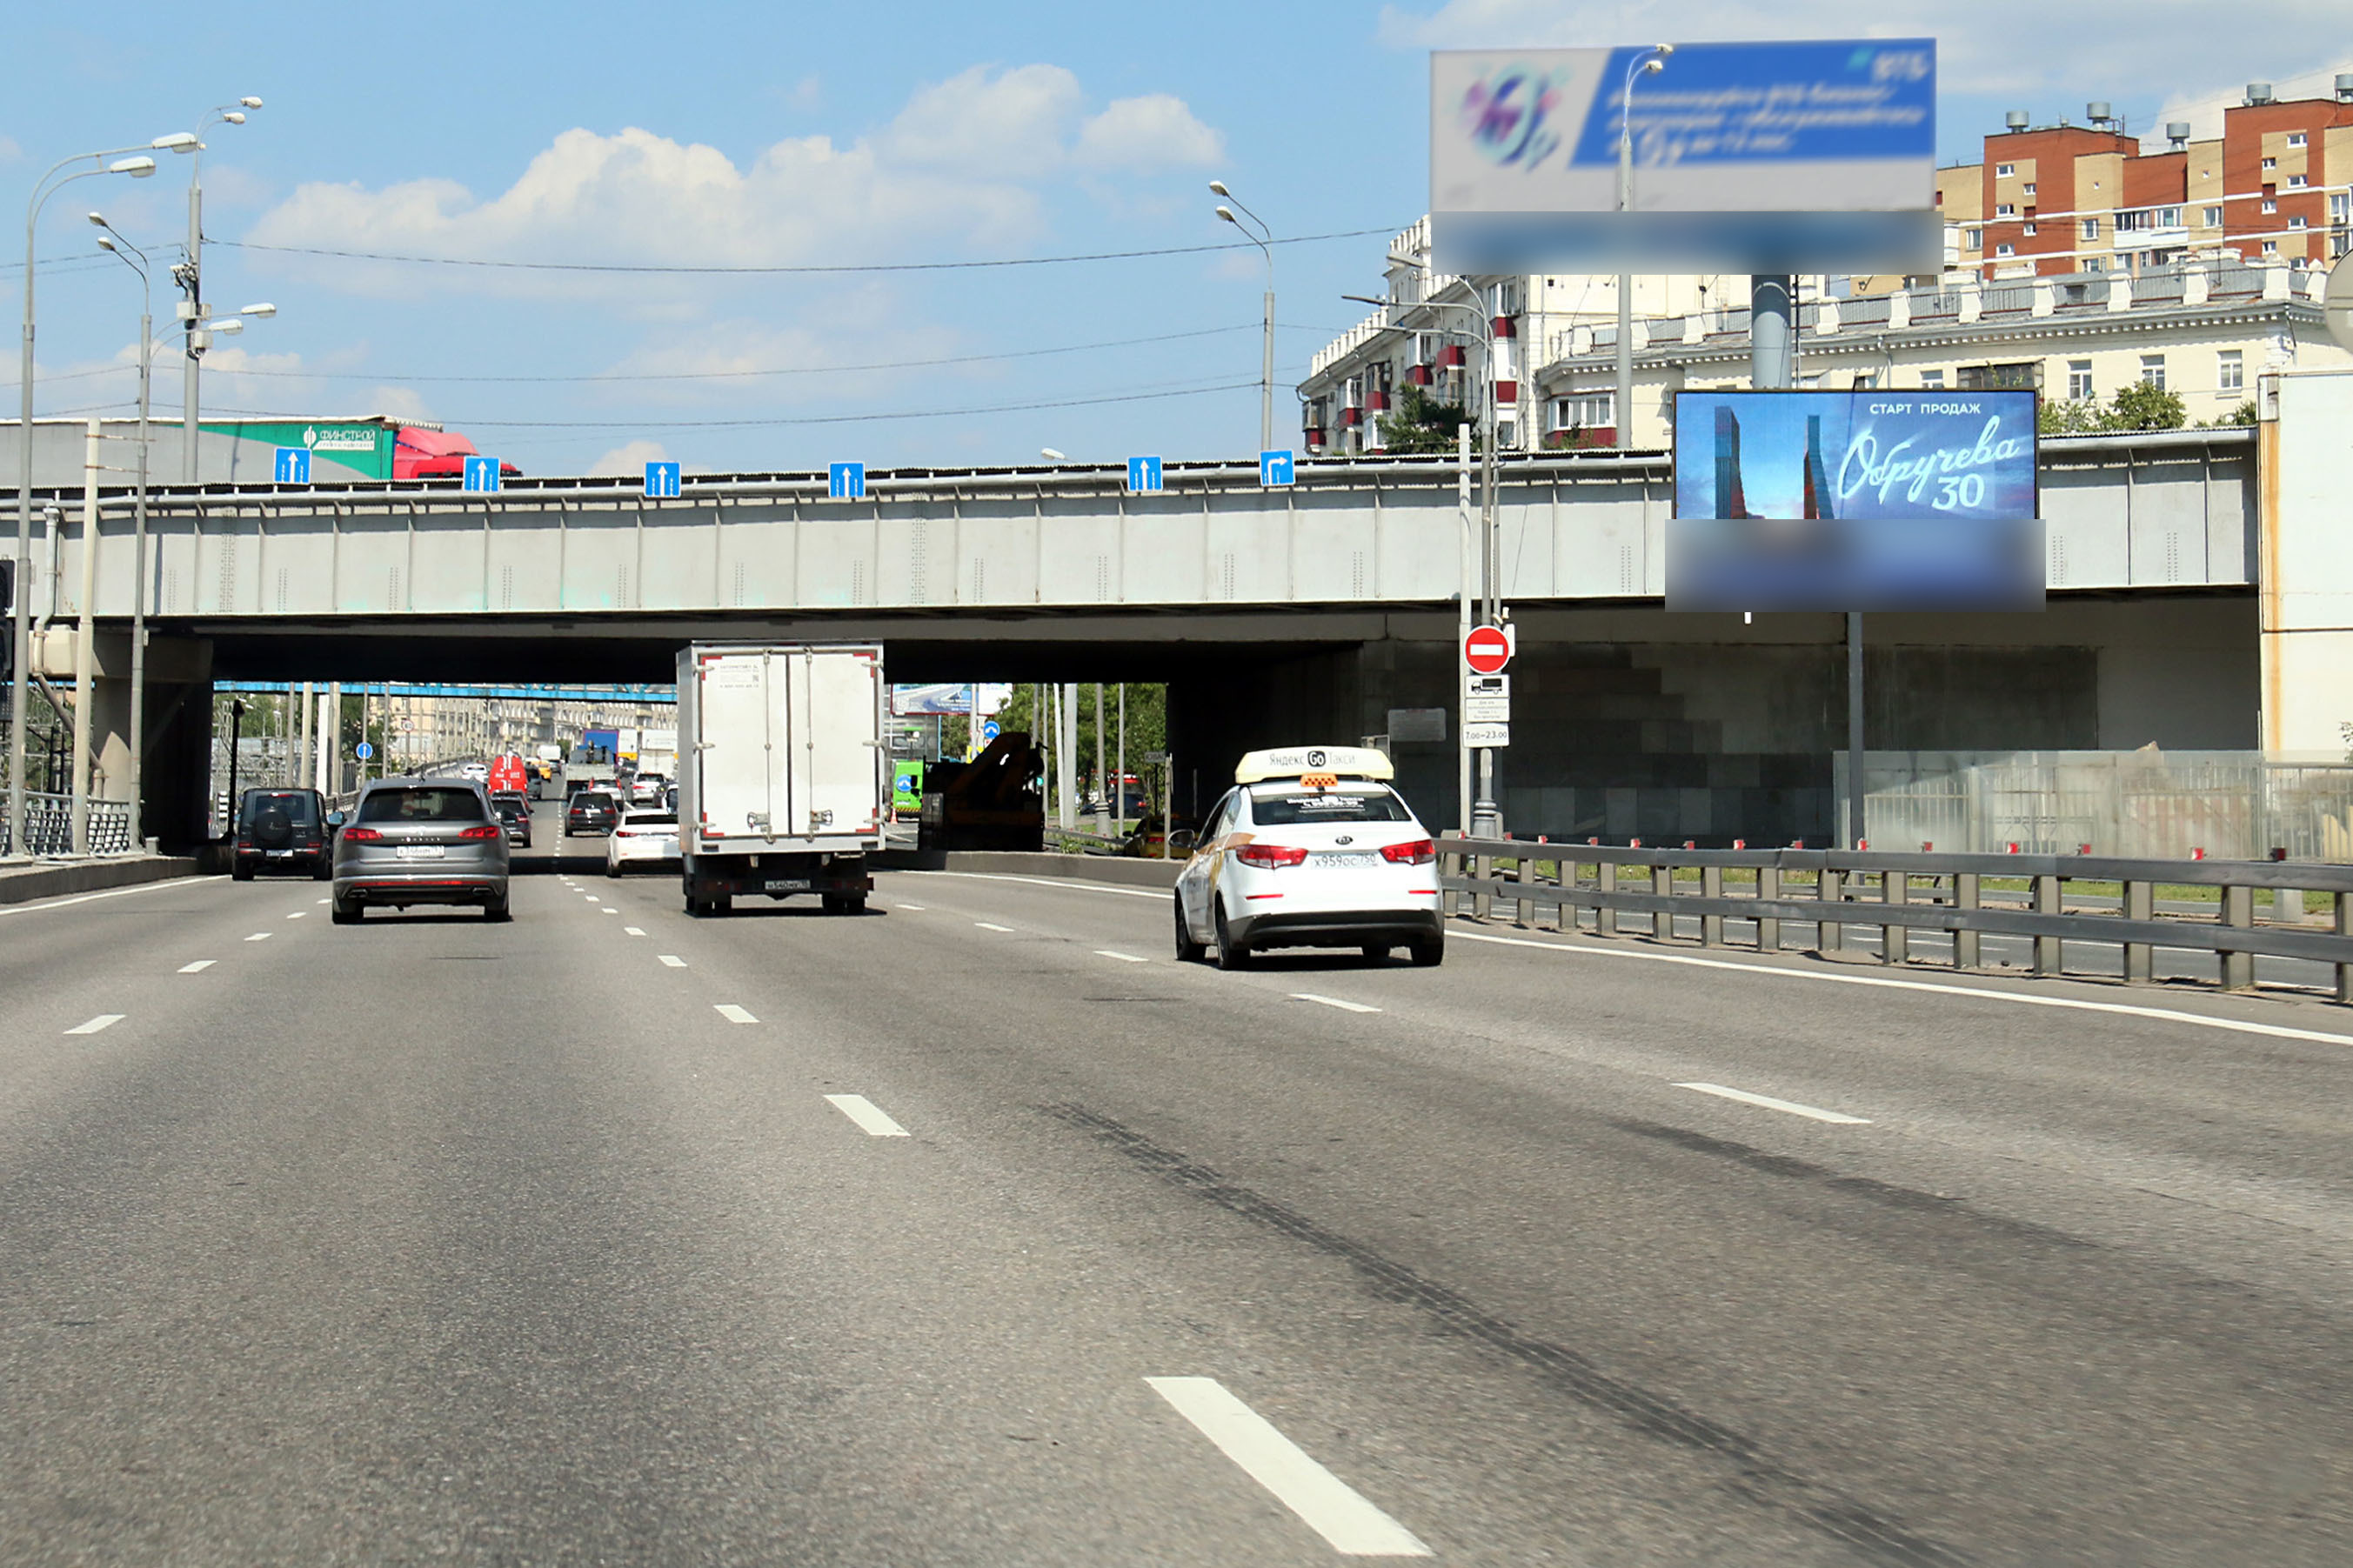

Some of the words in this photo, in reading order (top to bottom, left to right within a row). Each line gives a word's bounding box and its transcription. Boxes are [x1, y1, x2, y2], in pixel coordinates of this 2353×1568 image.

[1870, 404, 1912, 414] СТАРТ
[1921, 404, 1981, 415] ПРОДАЖ
[320, 430, 375, 439] ФИНСТРОЙ
[1837, 415, 2020, 504] Обручева
[1932, 473, 1985, 510] 30
[1269, 753, 1305, 766] Яндекс
[1309, 751, 1325, 765] Go
[1329, 751, 1355, 764] Такси
